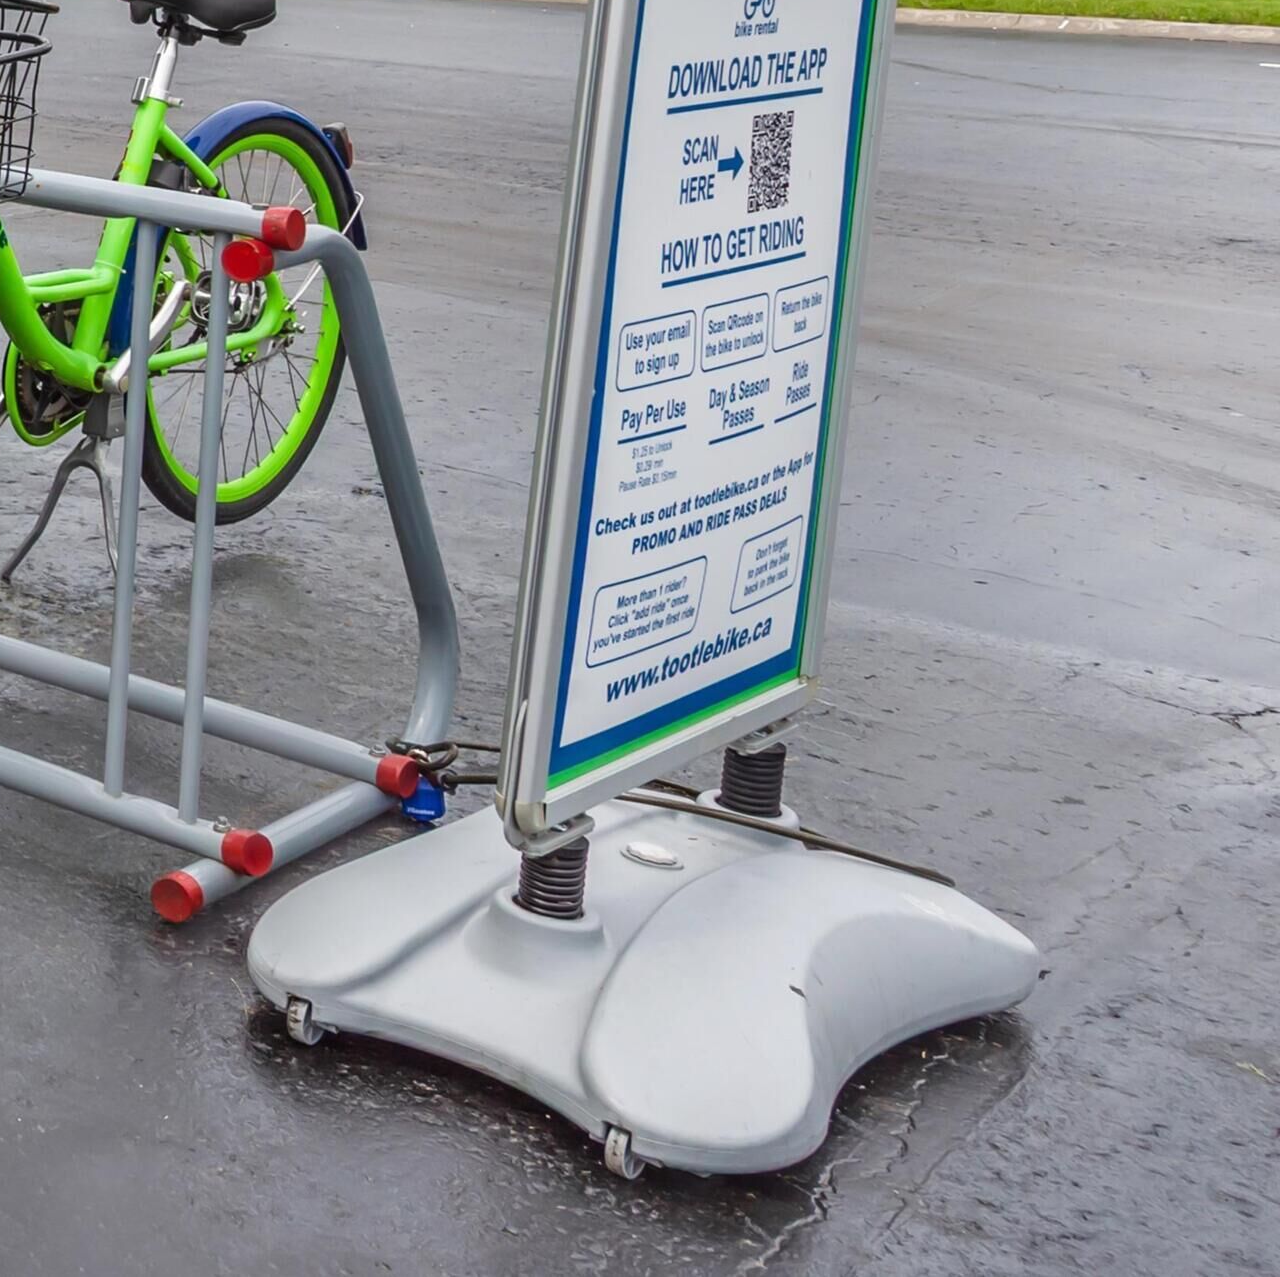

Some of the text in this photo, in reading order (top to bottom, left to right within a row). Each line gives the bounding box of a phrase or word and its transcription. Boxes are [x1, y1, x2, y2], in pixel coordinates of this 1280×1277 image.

[734, 19, 779, 38] bike rental
[667, 47, 828, 99] DOWNLOAD THE APP
[682, 135, 719, 166] SCAN
[679, 174, 715, 205] HERE
[661, 216, 804, 274] HOW TO GET RIDING
[782, 292, 822, 315] Return the bike
[626, 319, 691, 351] Use your email
[708, 320, 725, 335] Scan
[755, 311, 763, 323] on
[705, 330, 763, 358] the bike to unlock
[635, 353, 679, 375] to sign up
[792, 360, 809, 382] Ride
[709, 378, 770, 411] Day & Season
[785, 383, 811, 406] Passes
[621, 398, 686, 433] Pay Per Use
[723, 407, 754, 430] Passes
[595, 451, 814, 536] Check us out at tootlebike.ca or the App for
[632, 485, 788, 555] PROMO AND RIDE PASS DEALS
[617, 595, 637, 609] More
[639, 589, 657, 603] than
[664, 575, 687, 594] rider?
[608, 612, 629, 628] Click
[671, 594, 689, 608] once
[593, 633, 622, 653] you've
[623, 621, 651, 641] started
[651, 618, 664, 631] the
[606, 617, 772, 703] www.tootlebike.ca
